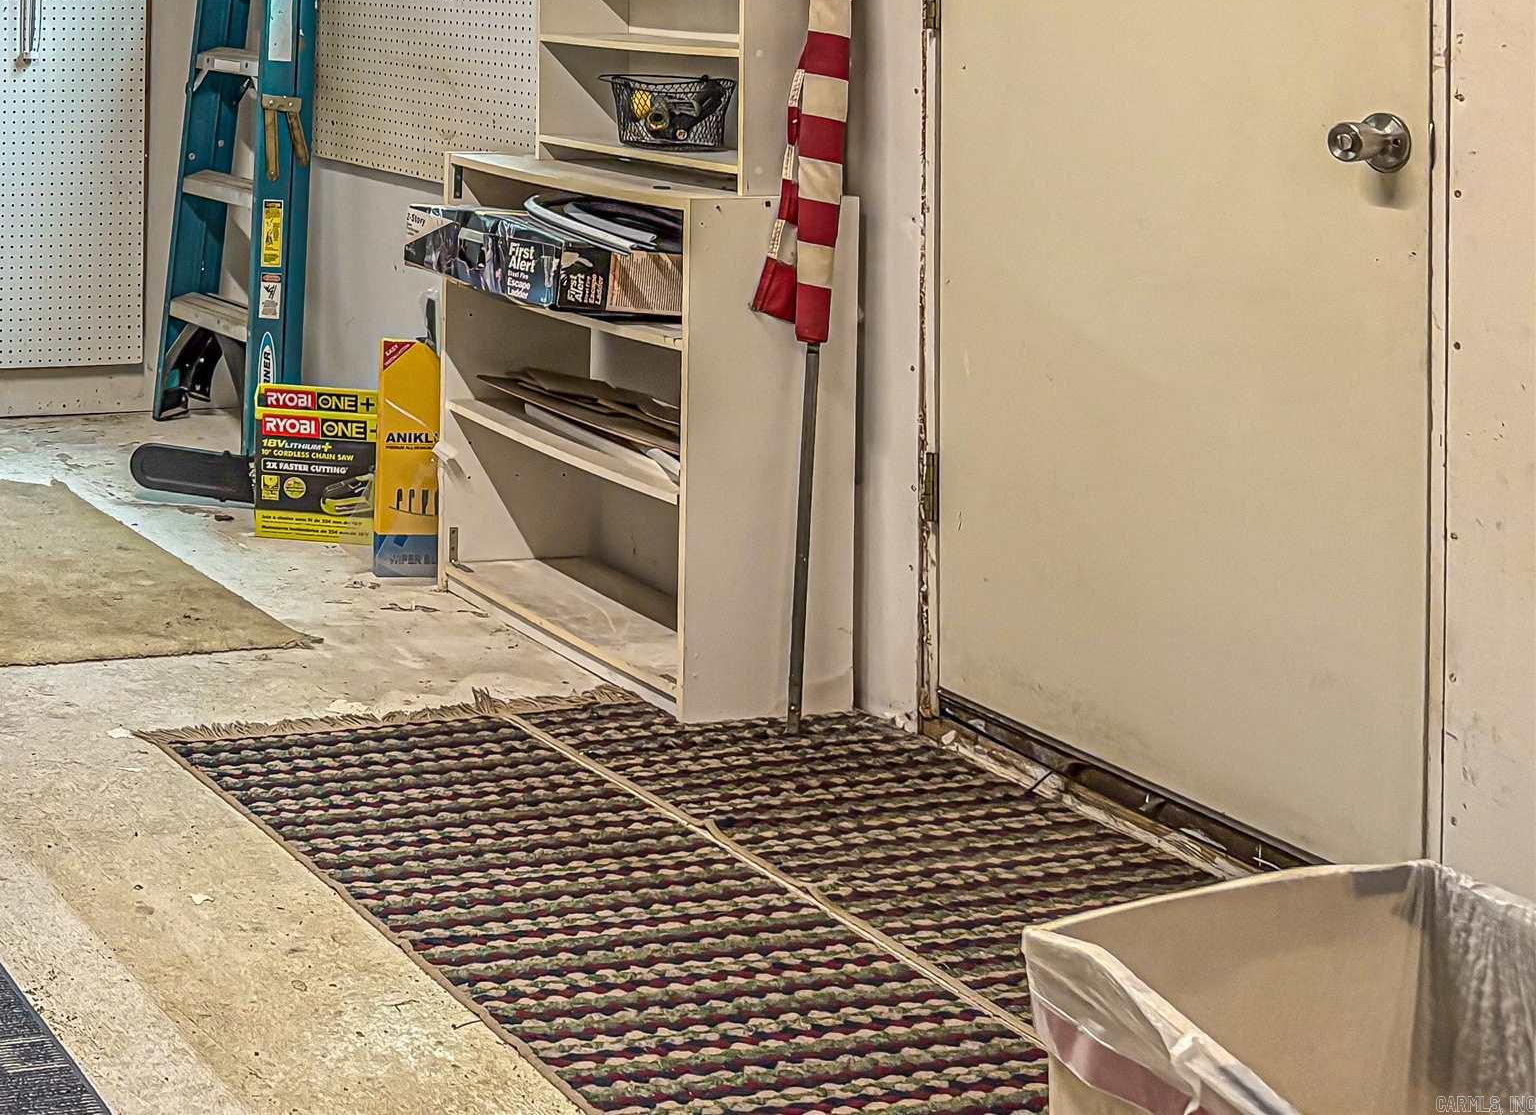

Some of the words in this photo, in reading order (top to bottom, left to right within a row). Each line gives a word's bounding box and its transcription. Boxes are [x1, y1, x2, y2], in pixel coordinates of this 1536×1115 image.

[508, 242, 535, 260] First
[508, 255, 536, 273] Alert
[266, 391, 313, 408] RYOBI
[264, 417, 316, 435] RYOBI
[273, 449, 310, 459] CORDLESS
[311, 452, 336, 460] CHAIN
[265, 461, 278, 469] 2X
[279, 462, 309, 472] FASTER
